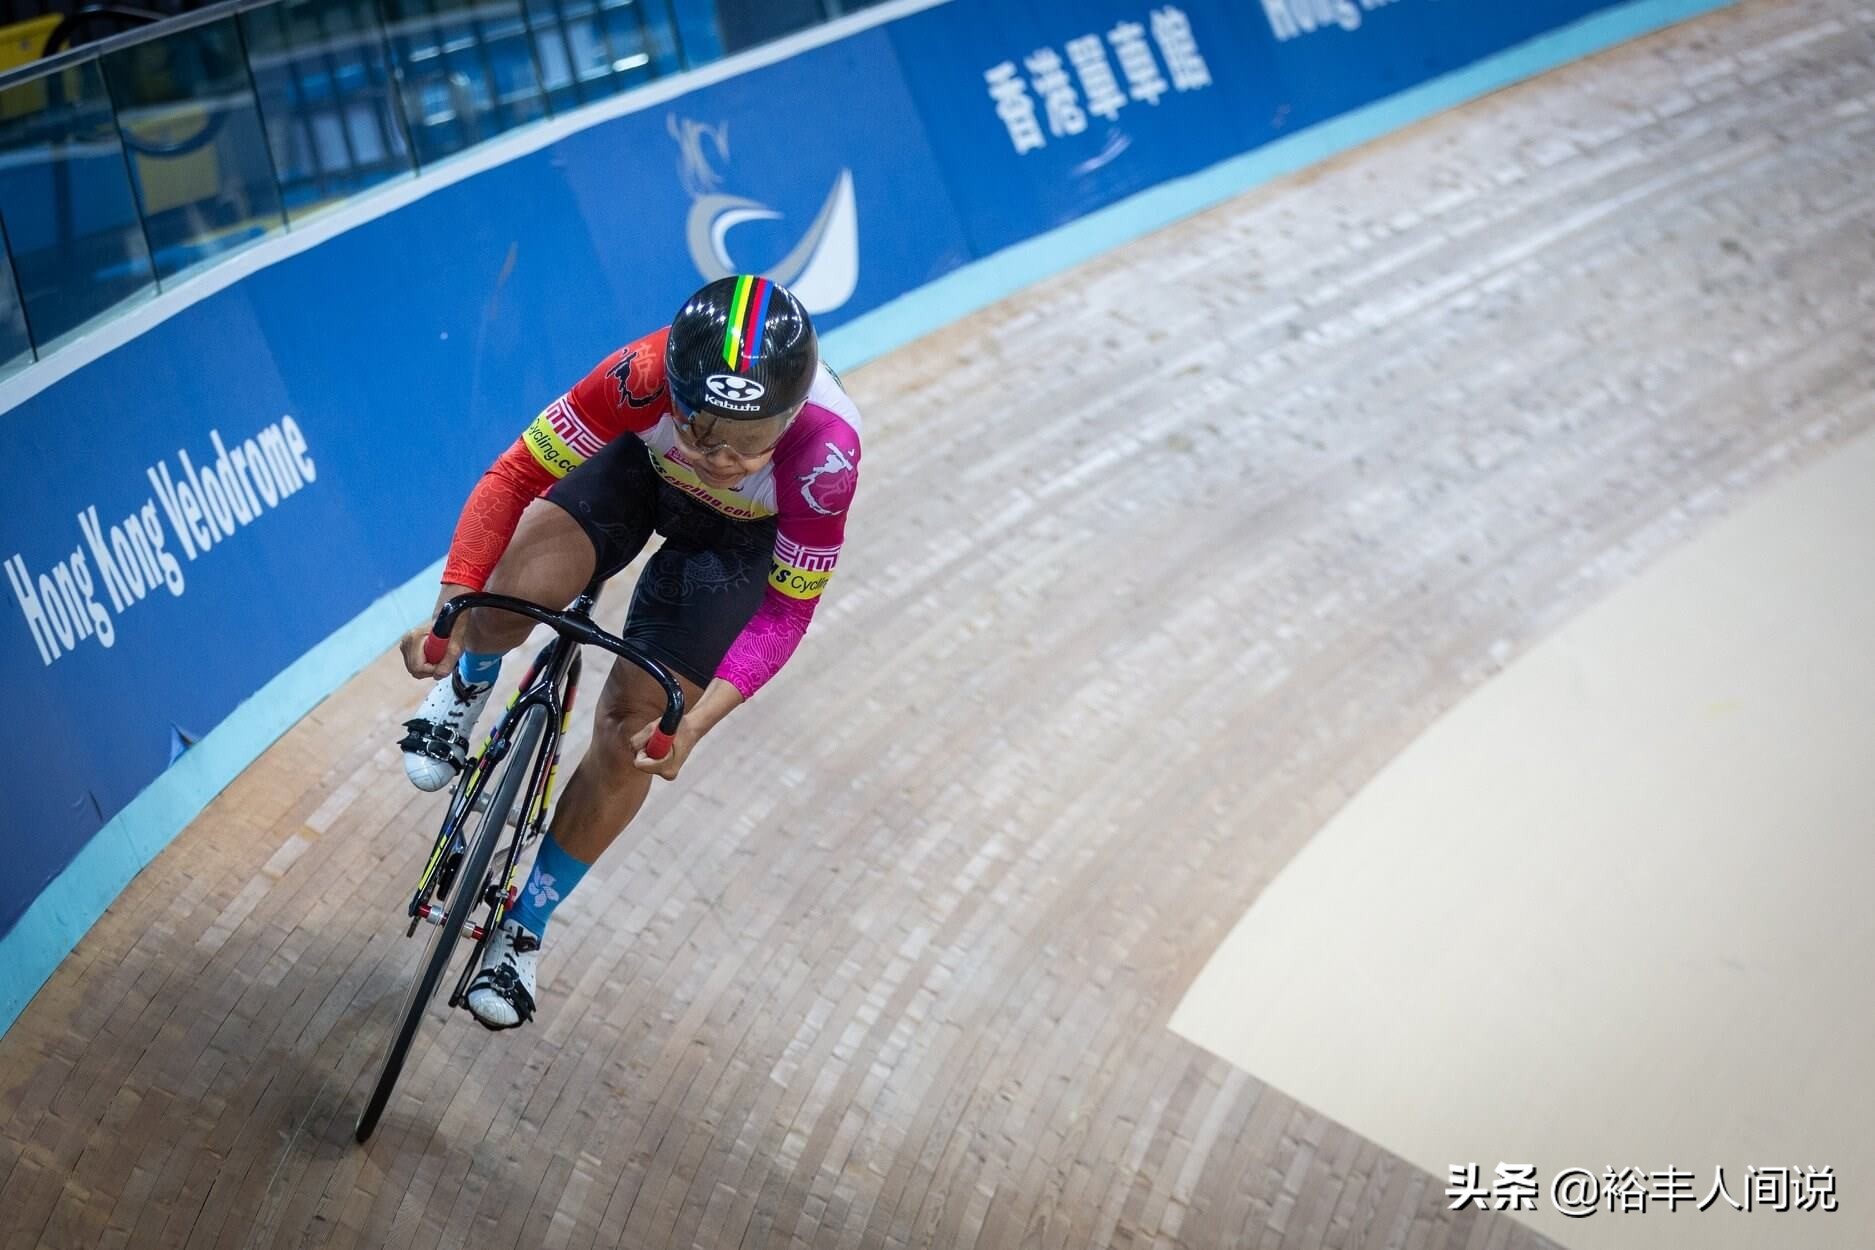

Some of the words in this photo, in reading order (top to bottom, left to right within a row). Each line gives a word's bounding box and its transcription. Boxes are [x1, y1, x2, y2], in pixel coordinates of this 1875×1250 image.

[704, 393, 761, 412] Kabuto
[4, 544, 115, 667] Hong
[77, 498, 185, 615] Kong
[147, 414, 317, 561] Velodrome
